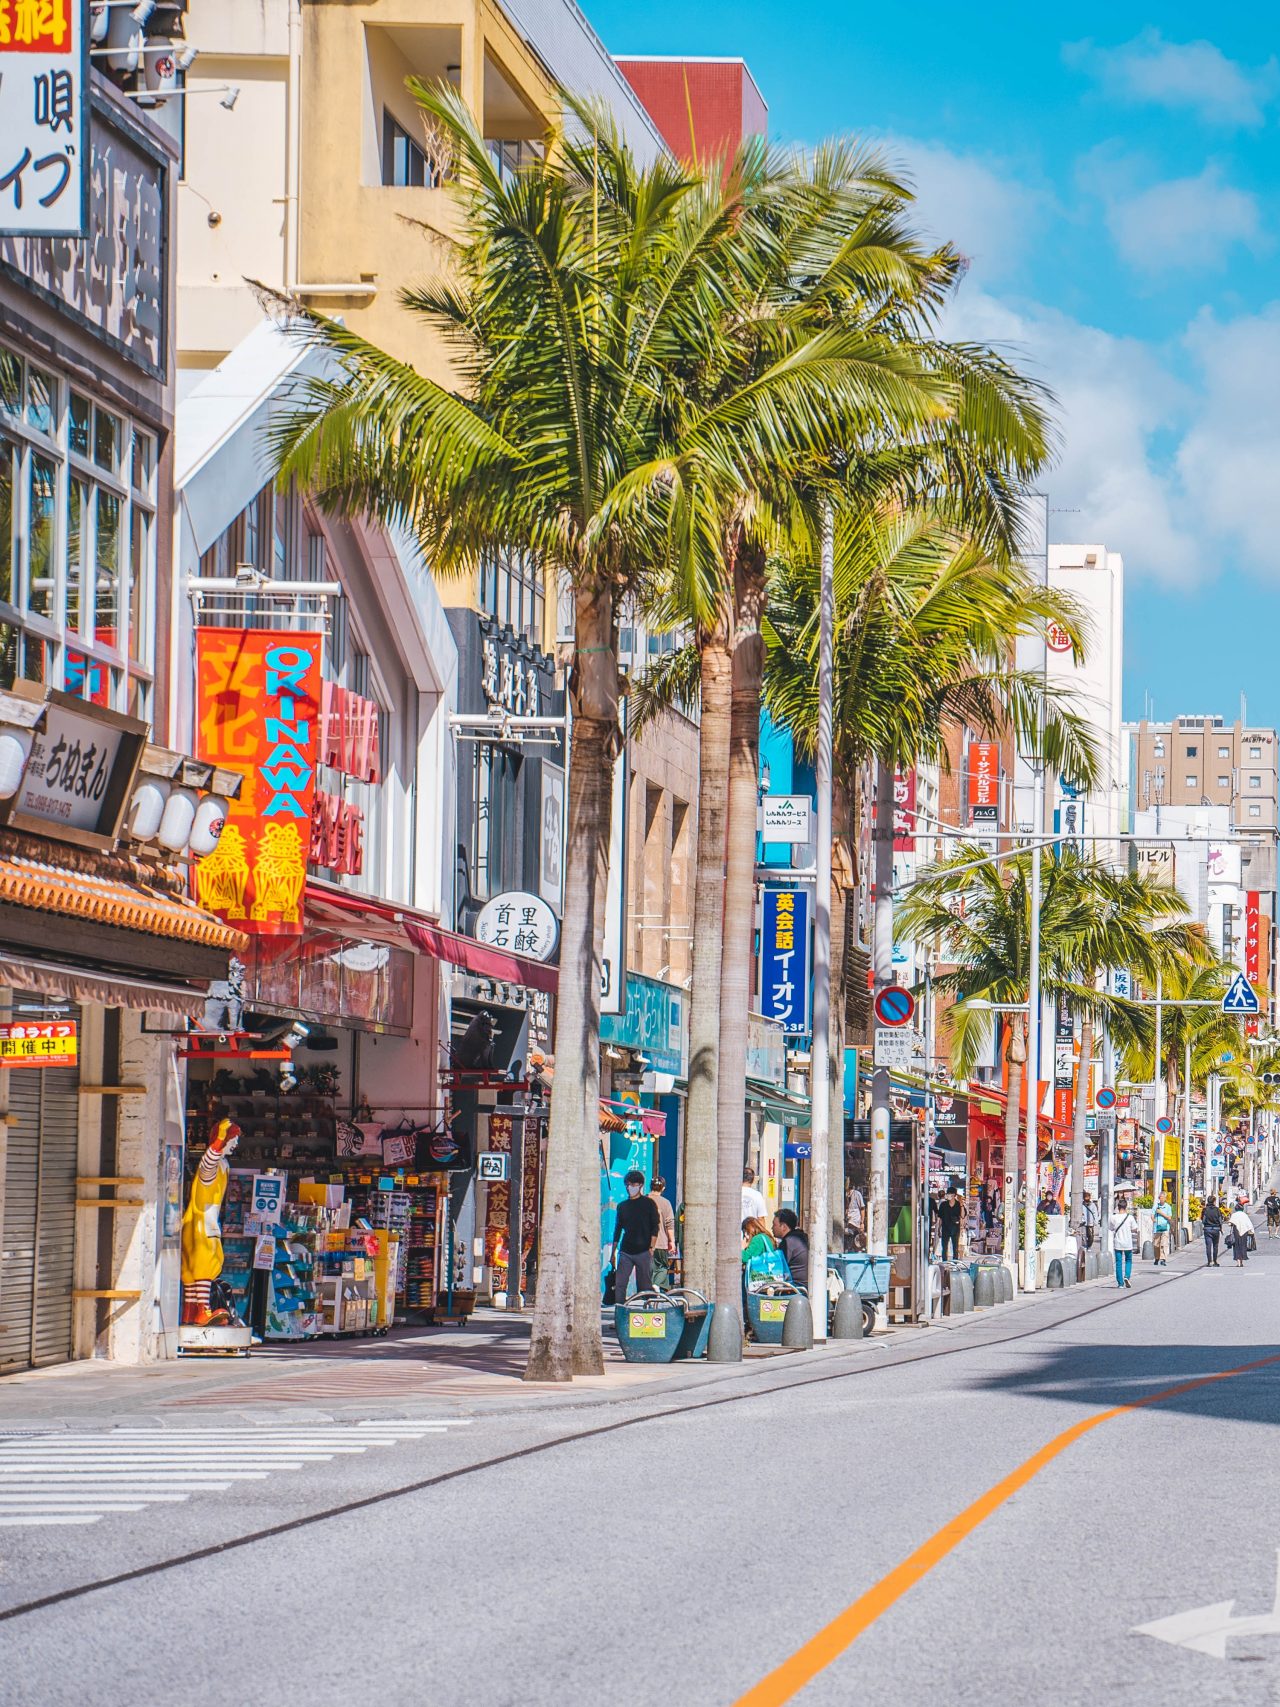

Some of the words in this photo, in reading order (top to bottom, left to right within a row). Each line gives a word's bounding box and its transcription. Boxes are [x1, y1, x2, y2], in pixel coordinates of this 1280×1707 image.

[33, 69, 73, 133] 唄
[1053, 628, 1069, 645] 福
[258, 645, 314, 818] OKINAWA
[495, 903, 538, 927] 首里
